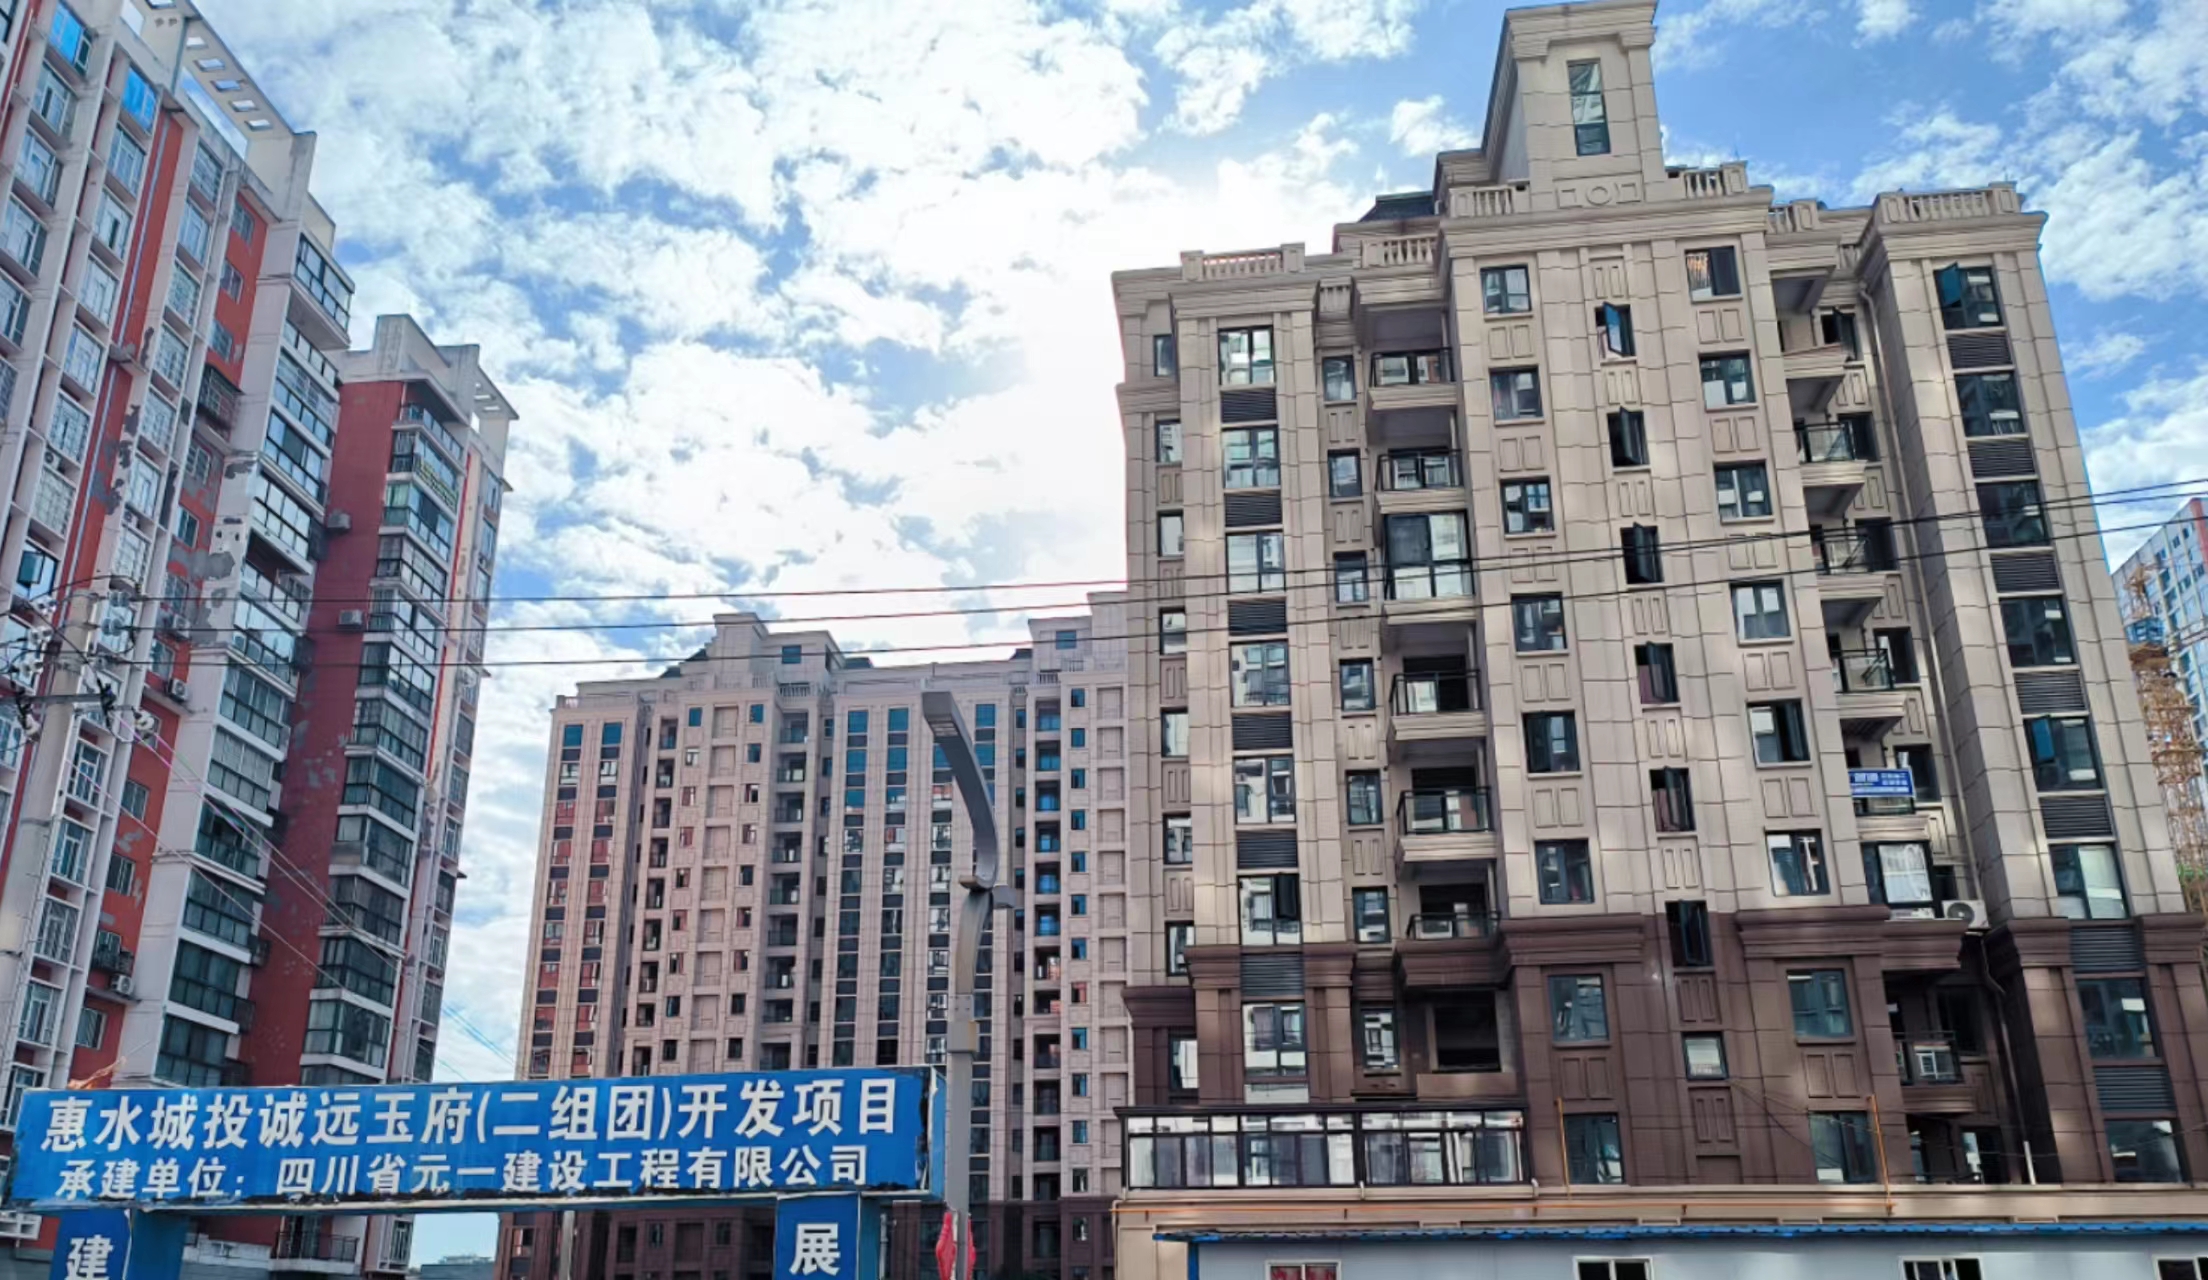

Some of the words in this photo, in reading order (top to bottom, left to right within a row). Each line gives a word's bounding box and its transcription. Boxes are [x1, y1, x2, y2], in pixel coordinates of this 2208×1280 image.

[41, 1079, 896, 1153] 惠水城投诚远玉府(二组团)开发项目
[64, 1234, 113, 1280] 建
[789, 1223, 840, 1275] 展
